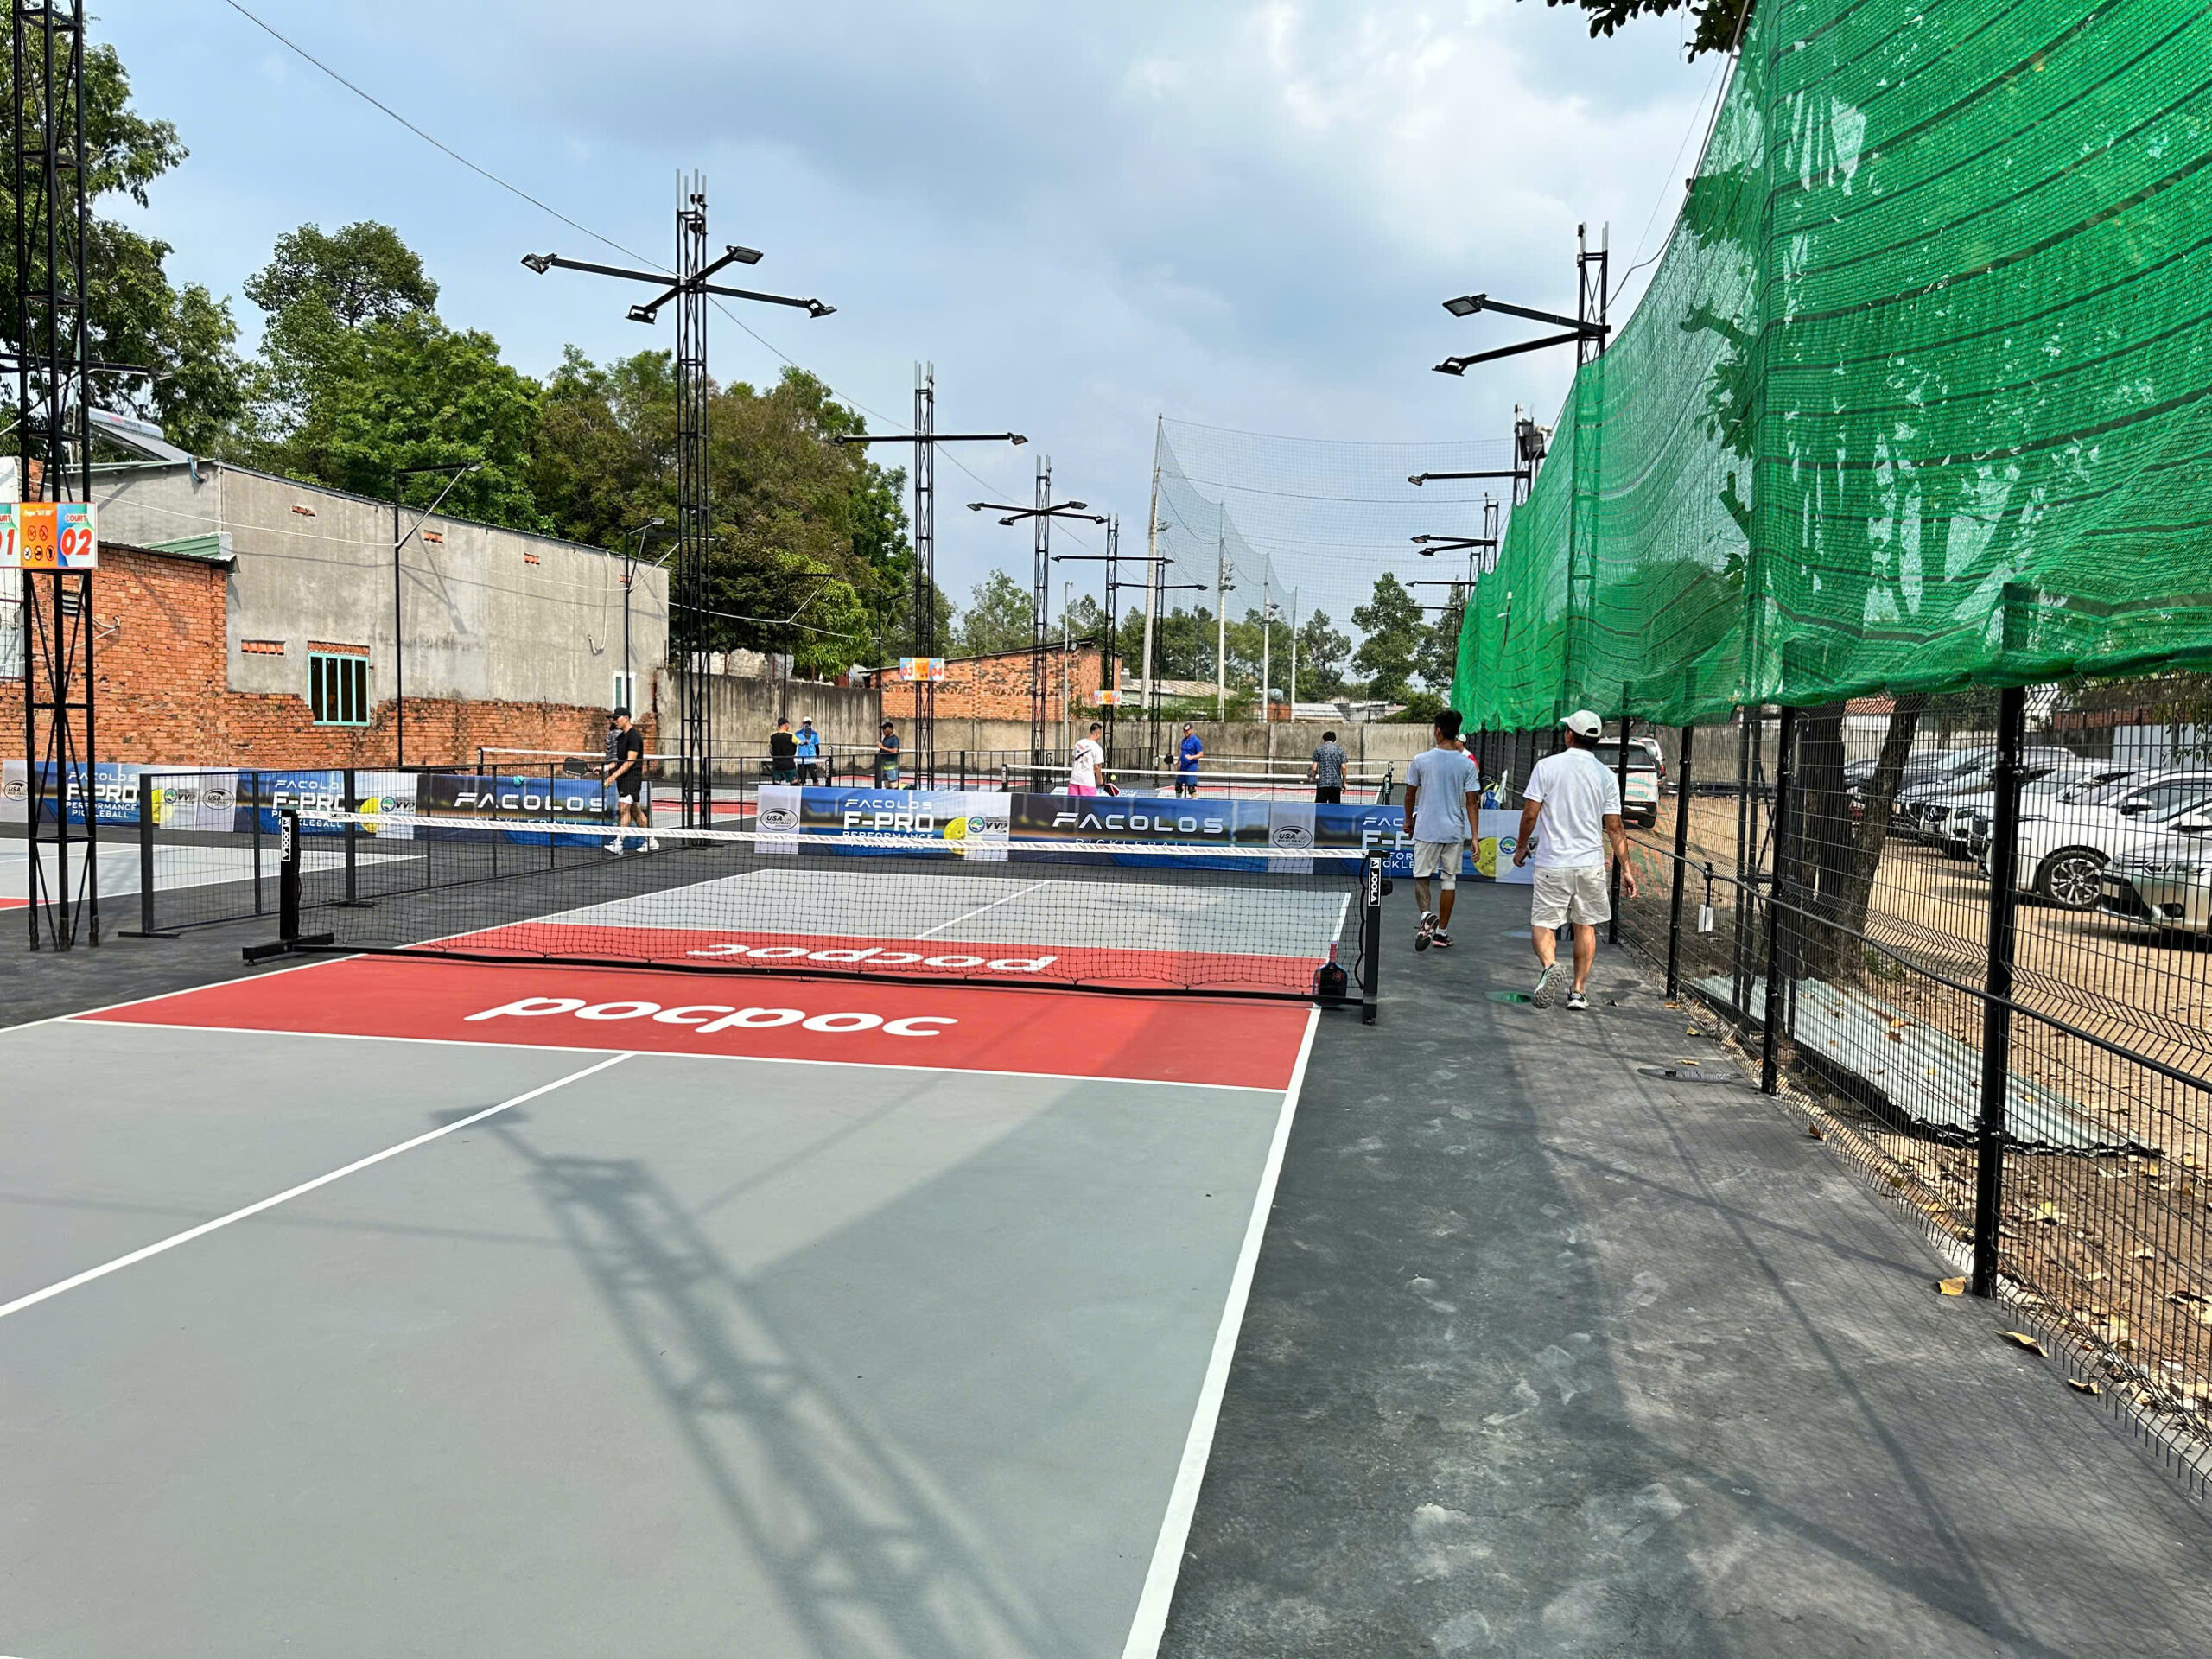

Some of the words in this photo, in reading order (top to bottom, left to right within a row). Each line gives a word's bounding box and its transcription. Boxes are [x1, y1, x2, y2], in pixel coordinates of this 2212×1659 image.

[0, 528, 15, 555] 1
[61, 528, 92, 556] 02
[901, 666, 913, 677] 03
[931, 667, 943, 677] 04
[68, 772, 137, 782] FAOLOS
[275, 779, 345, 791] FACOLO
[454, 792, 607, 813] FACOLOS
[844, 798, 933, 810] FACOLOS
[72, 809, 129, 818] PICLEBALL
[843, 810, 934, 833] F-PRO
[1052, 811, 1224, 835] FACOLOS
[686, 943, 1059, 972] pocpoc
[464, 996, 958, 1037] pocpoc
